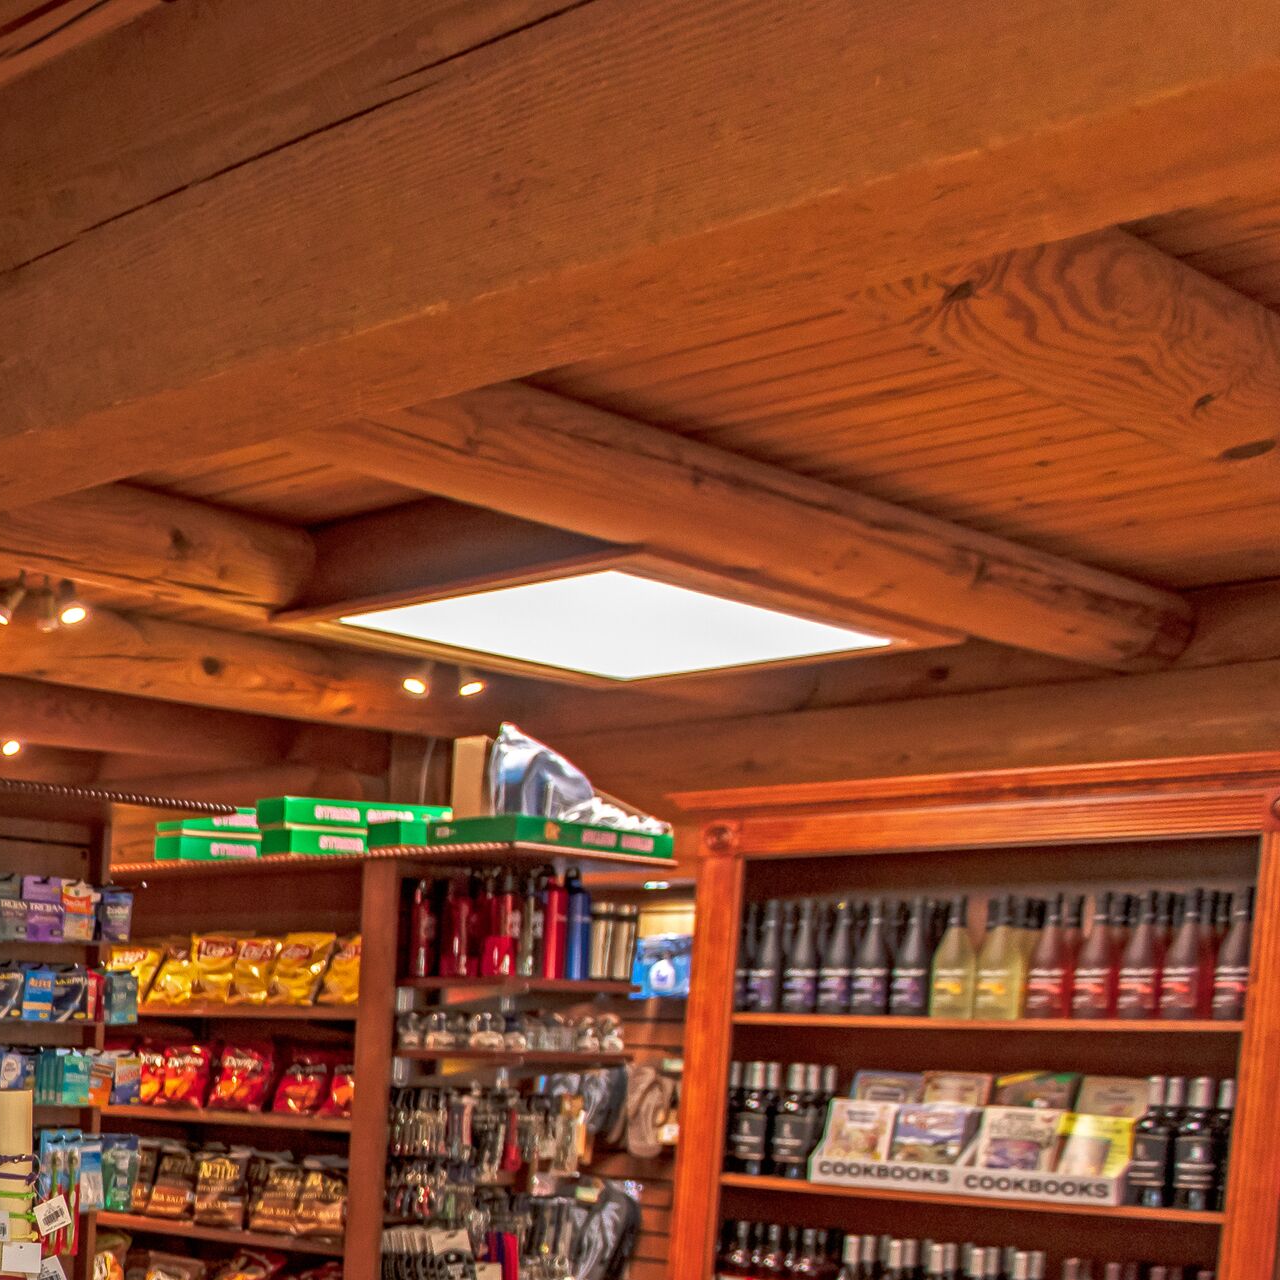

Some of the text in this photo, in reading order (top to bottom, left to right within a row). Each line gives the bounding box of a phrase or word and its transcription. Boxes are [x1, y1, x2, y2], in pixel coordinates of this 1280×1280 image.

[29, 902, 64, 912] TROJAN
[819, 1161, 949, 1184] COOKBOOKS
[964, 1174, 1109, 1198] COOKBOOKS
